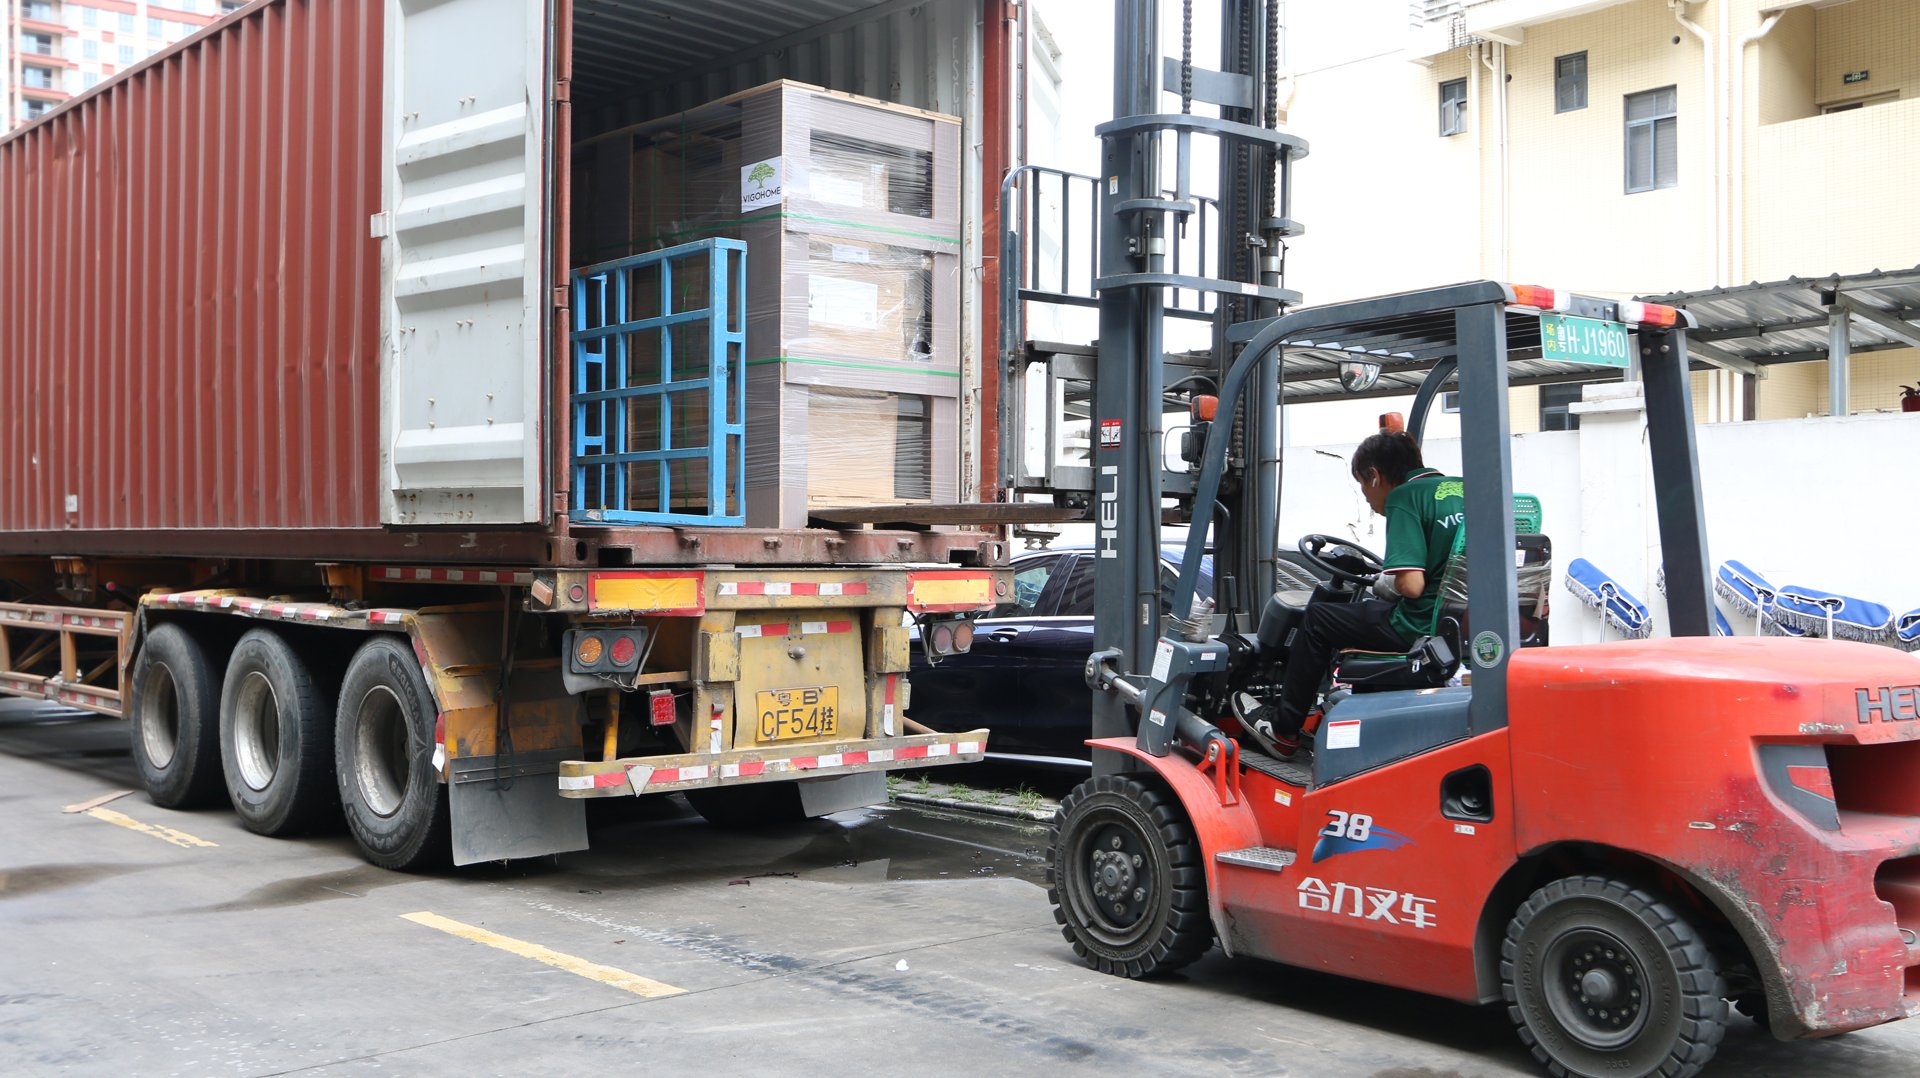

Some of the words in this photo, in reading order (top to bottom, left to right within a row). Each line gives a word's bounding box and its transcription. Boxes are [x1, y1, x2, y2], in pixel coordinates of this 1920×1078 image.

[743, 187, 781, 203] VIGOHOME
[1101, 466, 1118, 558] HELI
[1323, 809, 1373, 842] 38
[1296, 876, 1437, 929] 合力叉车
